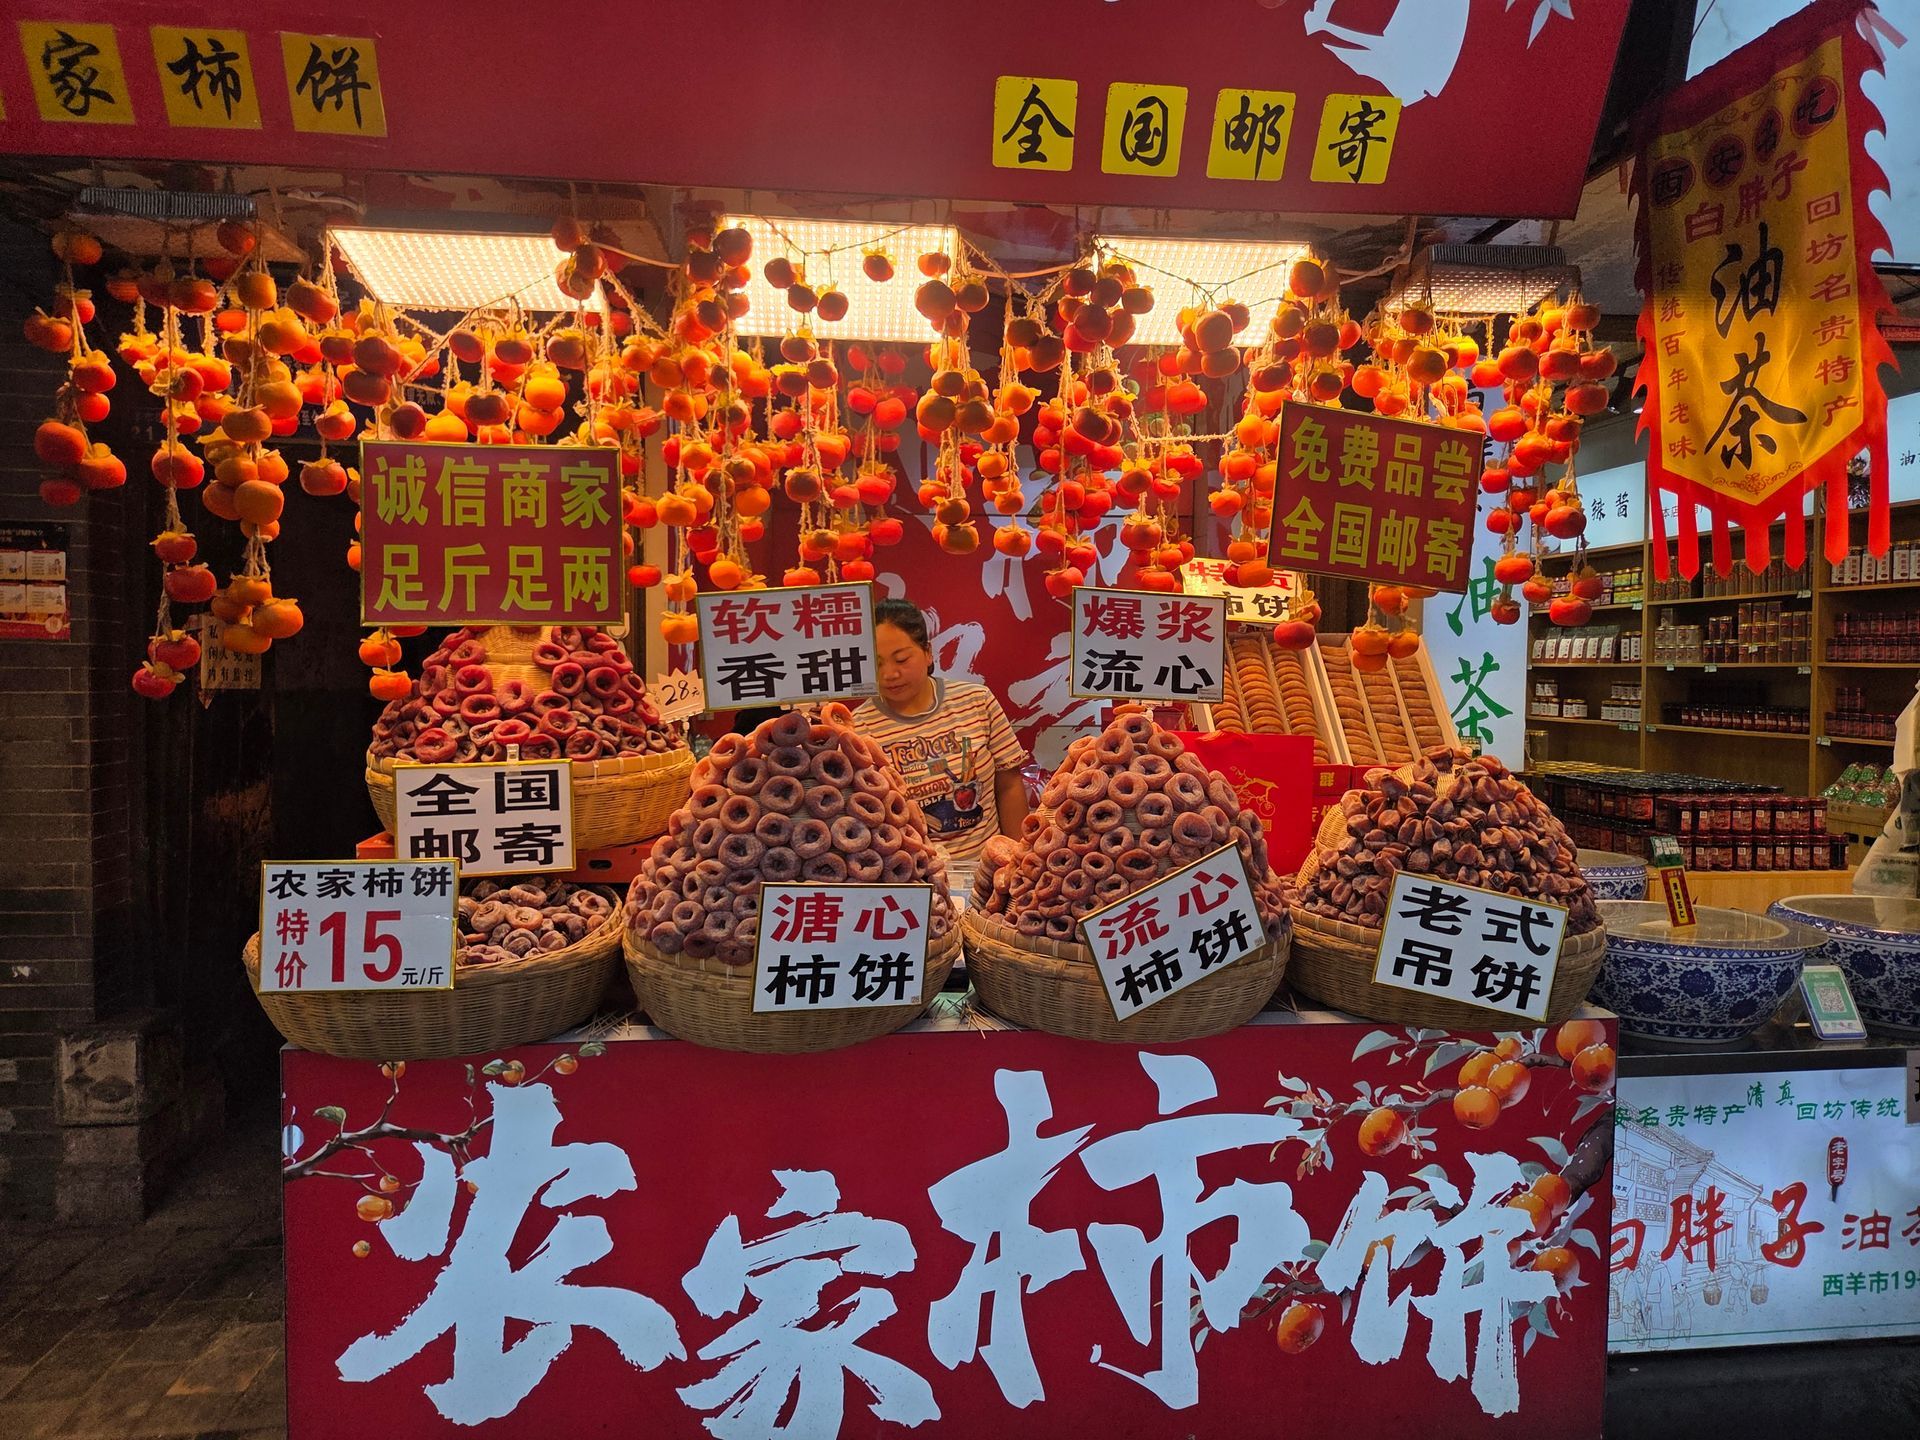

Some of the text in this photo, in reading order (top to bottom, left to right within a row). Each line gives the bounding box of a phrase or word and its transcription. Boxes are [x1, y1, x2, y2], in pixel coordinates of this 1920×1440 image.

[41, 29, 371, 128] 家柿饼
[1001, 83, 1387, 183] 全国邮寄
[1684, 151, 1809, 244] 白胖子
[1805, 191, 1859, 428] 回坊名贵特产
[1657, 261, 1697, 460] 传统百年老味
[1704, 221, 1808, 471] 油茶
[371, 453, 612, 529] 诚信商家
[1288, 415, 1473, 505] 免费品尝
[1280, 495, 1465, 581] 全国邮寄
[373, 542, 612, 613] 足斤足两
[709, 590, 863, 645] 软糯
[1081, 594, 1216, 644] 爆浆
[716, 646, 868, 701] 香甜
[1080, 648, 1215, 695] 流心
[405, 769, 561, 818] 全国
[409, 822, 565, 871] 邮寄
[267, 866, 453, 900] 农家柿饼
[769, 891, 921, 944] 溏心
[1098, 870, 1240, 960] 流心
[274, 908, 309, 990] 特价
[319, 910, 445, 987] 15 元/斤
[1397, 885, 1555, 957] 老式
[764, 951, 915, 1006] 柿饼
[1114, 908, 1253, 1008] 柿饼
[1391, 938, 1542, 1011] 吊饼
[1746, 1080, 1796, 1107] 清真
[1796, 1097, 1900, 1121] 回坊传统
[1831, 1139, 1849, 1183] 老字号
[334, 1050, 1561, 1440] 农家柿饼
[1822, 1269, 1920, 1297] 西羊市19
